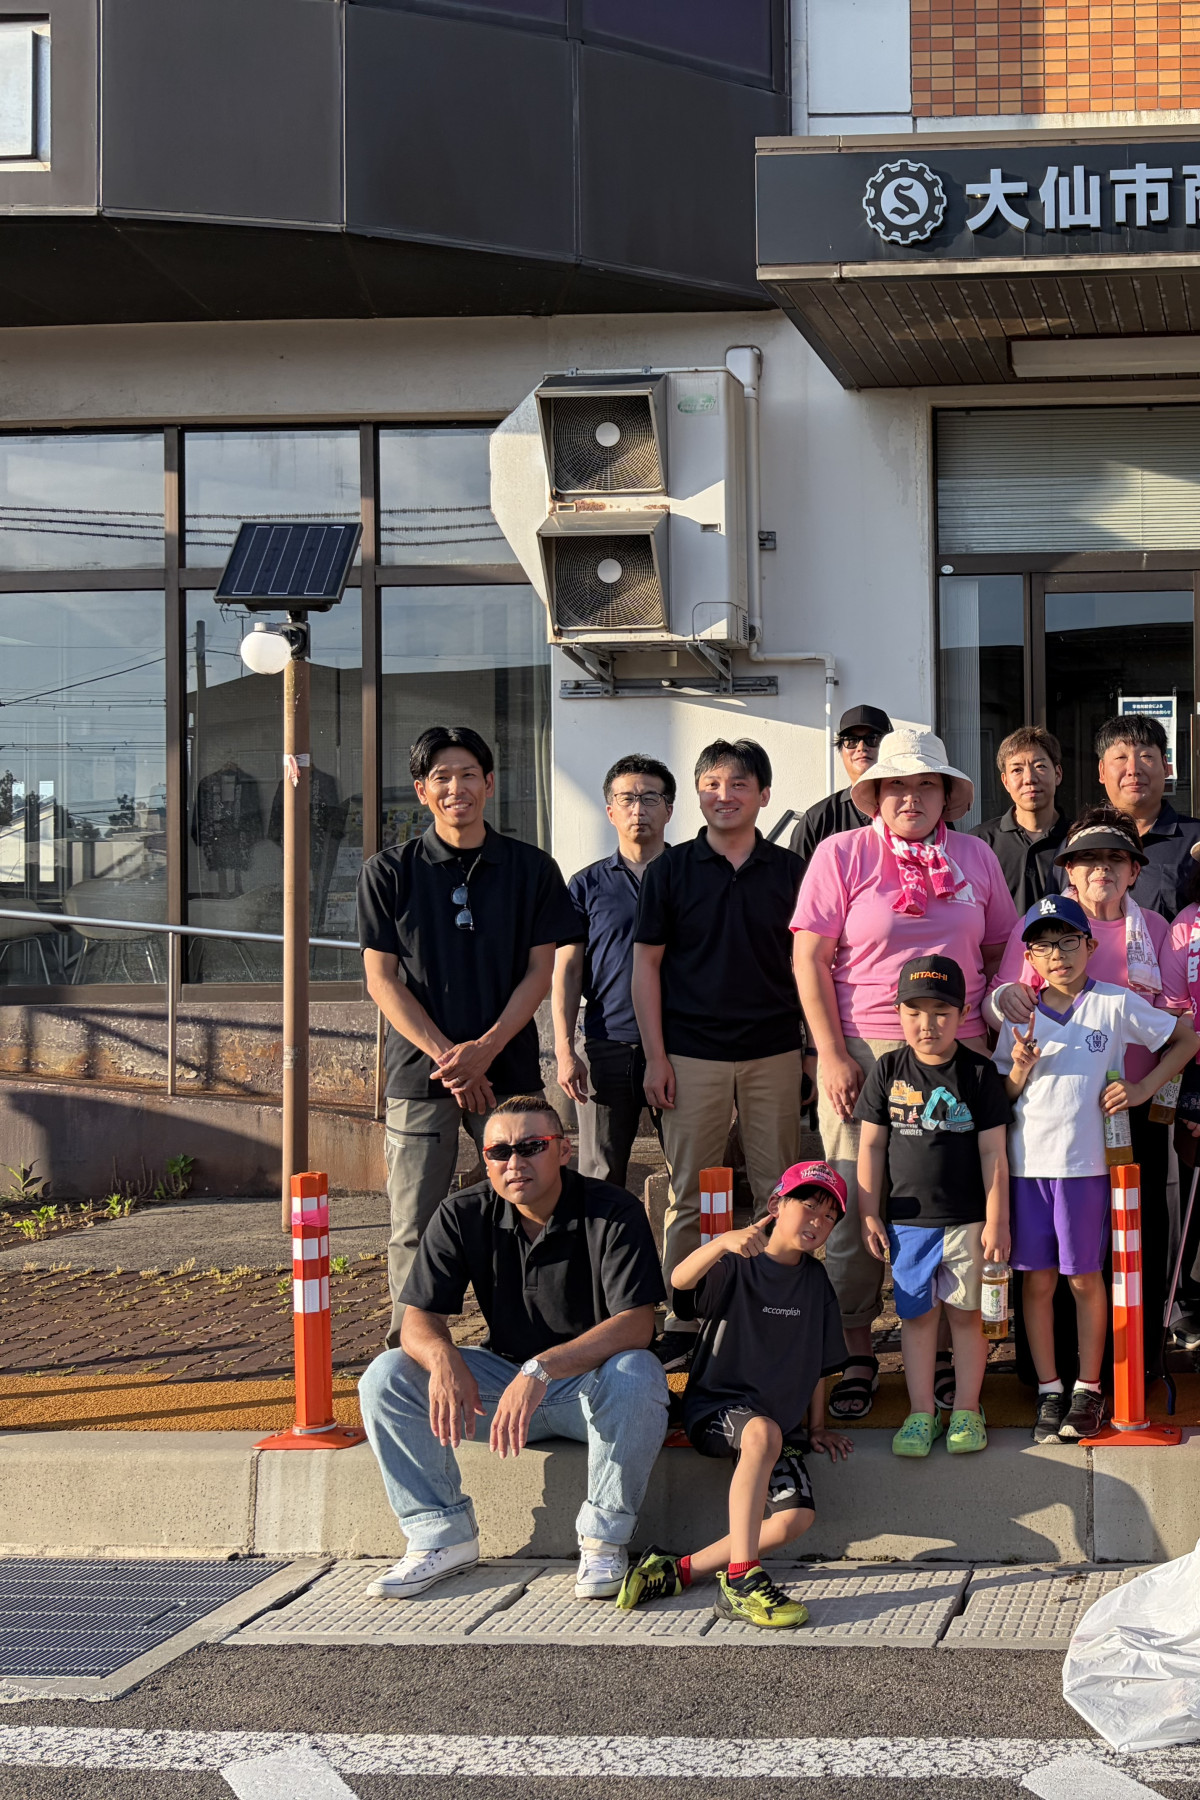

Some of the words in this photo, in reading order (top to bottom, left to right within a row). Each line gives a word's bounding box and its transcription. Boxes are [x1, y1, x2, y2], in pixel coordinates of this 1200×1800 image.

[1040, 898, 1057, 915] LA
[910, 971, 948, 981] HITACHI
[762, 1306, 801, 1317] accomplish
